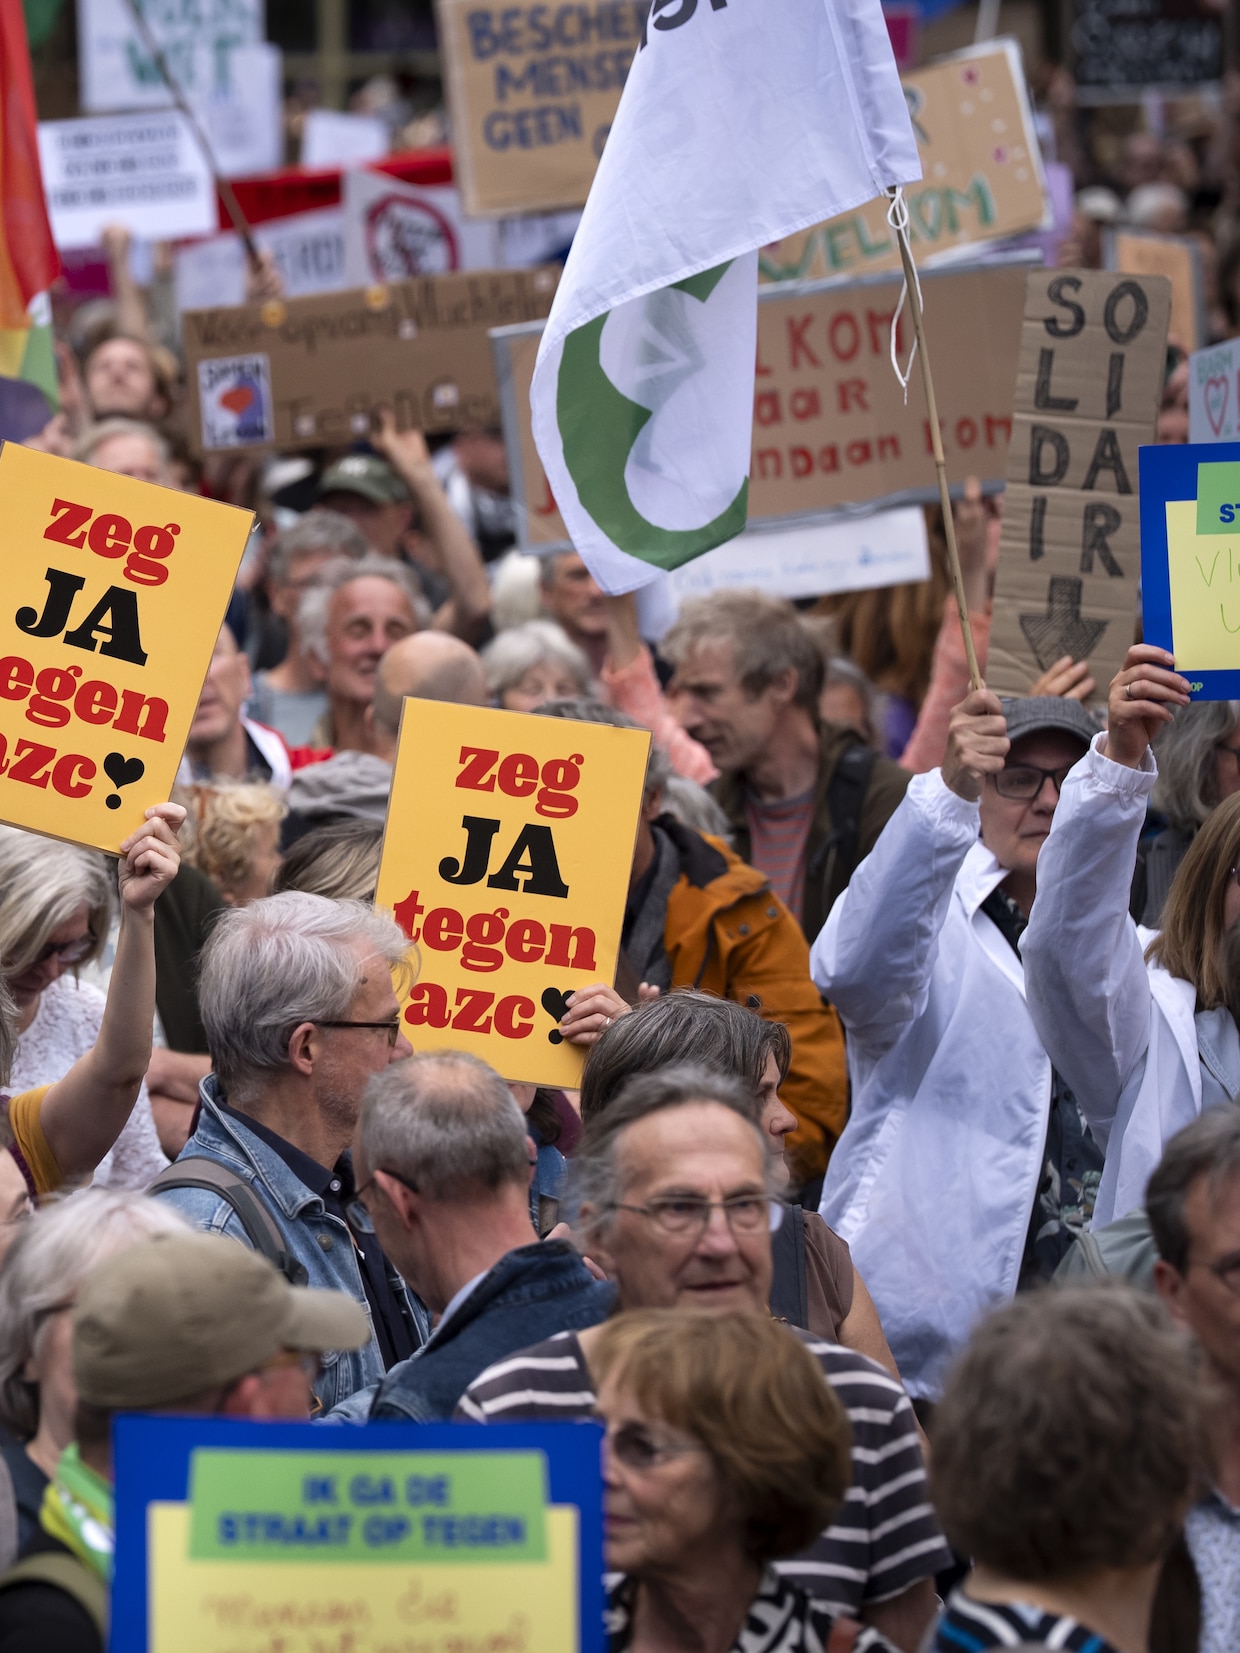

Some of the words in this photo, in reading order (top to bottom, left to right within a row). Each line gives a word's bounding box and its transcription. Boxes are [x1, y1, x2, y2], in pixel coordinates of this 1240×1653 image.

[496, 52, 636, 103] MENSE
[482, 104, 583, 152] GEEN
[43, 498, 181, 586] zeg
[15, 567, 149, 667] JA
[455, 746, 585, 819] zeg
[438, 815, 569, 899] JA
[393, 890, 597, 973] tegen
[303, 1474, 337, 1507] IK
[349, 1473, 397, 1508] GA
[406, 1473, 451, 1508] DE
[218, 1511, 352, 1548] STRAAT
[363, 1513, 412, 1549] OP
[422, 1512, 526, 1549] TEGEN
